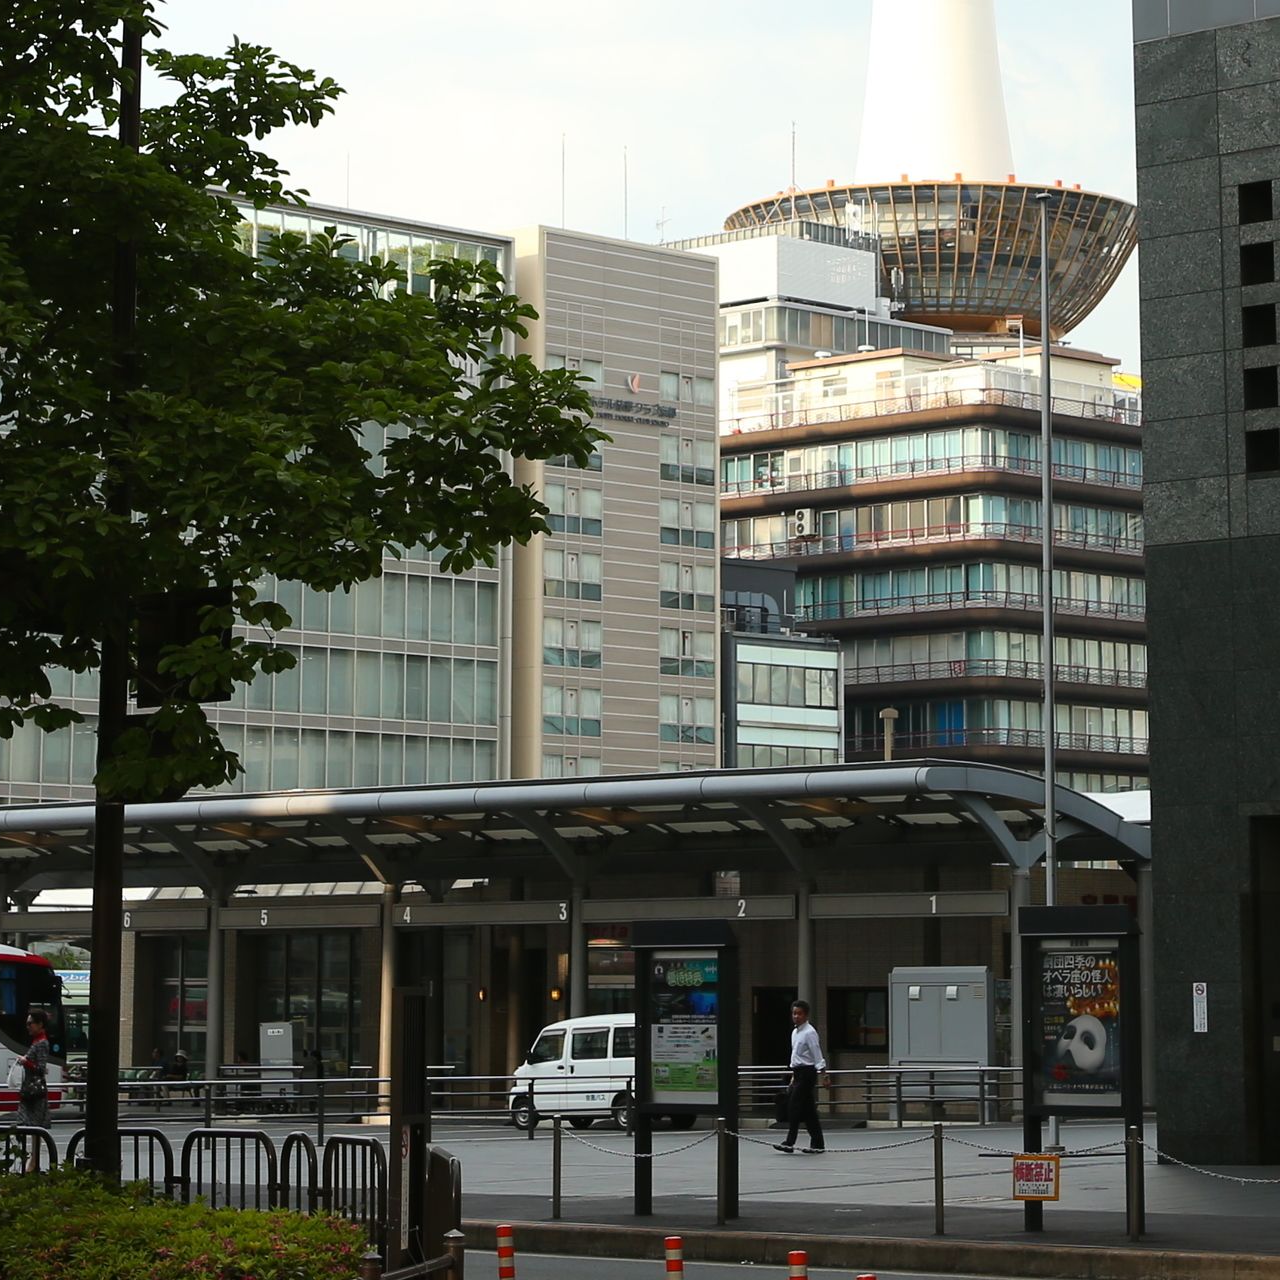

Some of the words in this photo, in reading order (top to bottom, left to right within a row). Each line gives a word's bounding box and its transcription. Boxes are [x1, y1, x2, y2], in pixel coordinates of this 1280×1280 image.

[559, 903, 567, 921] 3
[737, 899, 746, 918] 2
[929, 895, 937, 914] 1
[123, 912, 131, 928] 6
[260, 910, 268, 926] 5
[403, 906, 411, 923] 4
[1043, 955, 1095, 969] 劇団四季の
[1043, 970, 1112, 983] オペラ座の怪人
